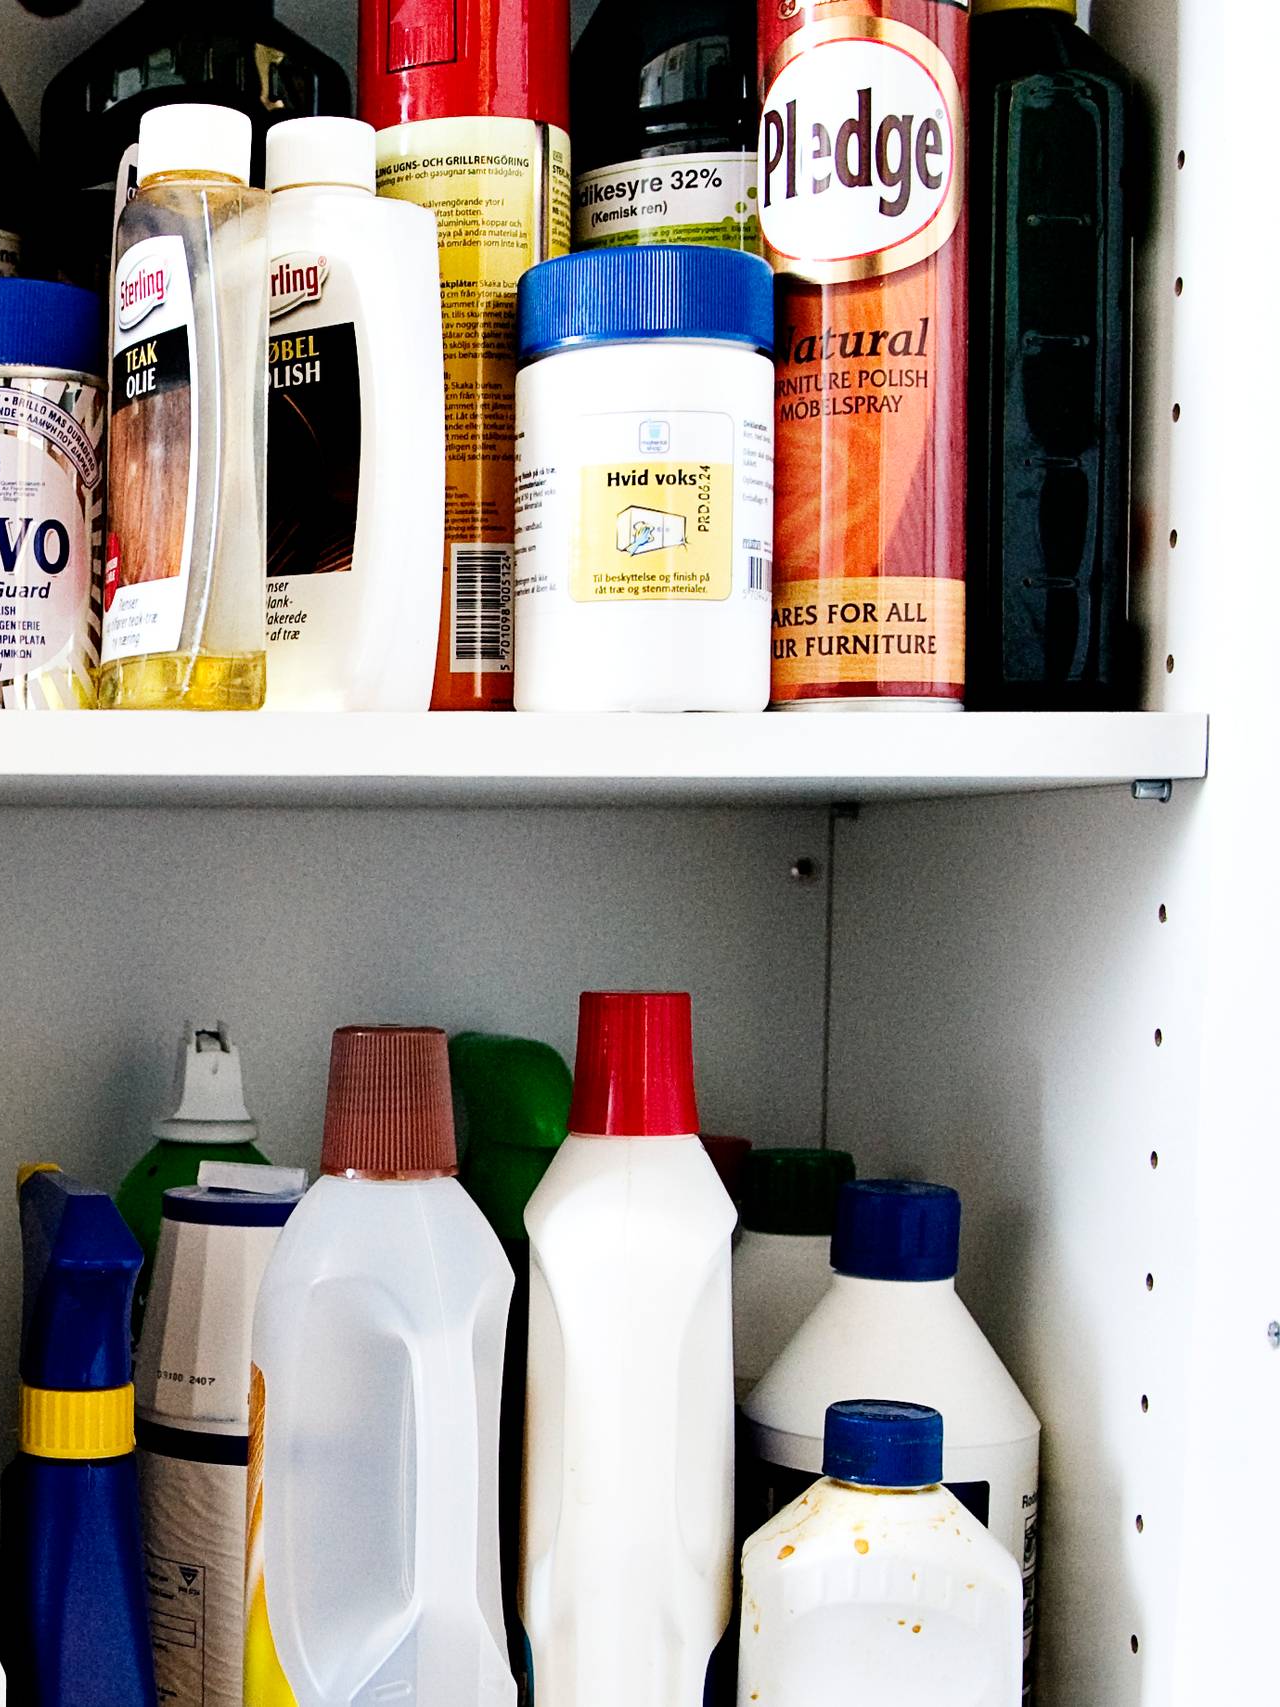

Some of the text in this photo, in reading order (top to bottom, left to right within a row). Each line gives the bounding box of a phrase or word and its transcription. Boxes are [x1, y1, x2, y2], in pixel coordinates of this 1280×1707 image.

[764, 88, 943, 216] Pledge
[394, 161, 420, 173] UGNS-
[423, 158, 443, 167] OCH
[446, 155, 529, 167] GRILLRENGÖRING
[671, 168, 722, 190] 32%
[592, 201, 667, 227] (Kemisk ren)
[120, 268, 164, 311] Sterling
[126, 341, 157, 373] TEAK
[126, 367, 156, 399] OLIE
[269, 361, 320, 389] LISH
[859, 369, 928, 388] POLISH
[48, 410, 67, 428] MAS
[781, 395, 902, 422] MÖBELSPRAY
[607, 469, 697, 486] Hvid voks
[698, 465, 710, 532] PRD.06.24
[266, 582, 289, 592] nser
[502, 556, 511, 601] 005124
[593, 573, 710, 584] Til beskyttelse og finish på
[595, 584, 708, 596] råt træ og stenmaterialer.
[266, 596, 293, 608] lank-
[772, 603, 927, 627] ARES FOR ALL
[20, 635, 45, 645] PLATA
[270, 628, 300, 641] af træ
[501, 608, 511, 655] 701098
[774, 634, 936, 659] UR FURNITURE
[189, 1376, 216, 1386] 2407
